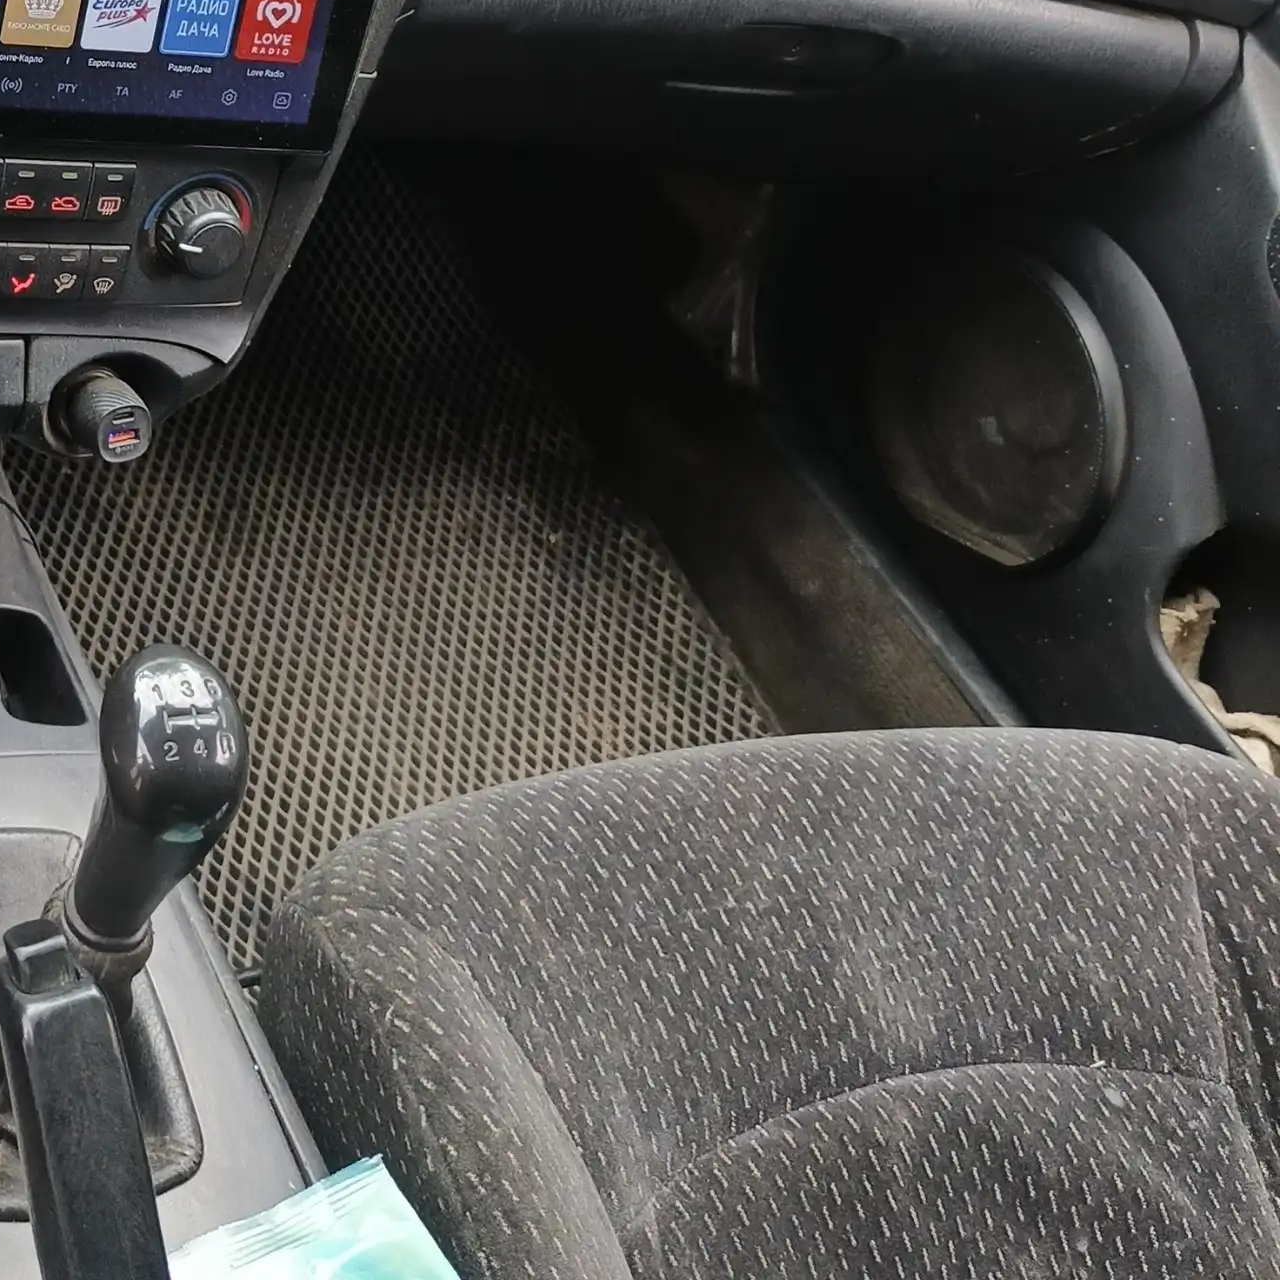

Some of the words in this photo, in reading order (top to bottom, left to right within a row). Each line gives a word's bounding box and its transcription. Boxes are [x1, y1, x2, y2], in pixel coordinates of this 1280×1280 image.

[176, 20, 219, 38] ДАЧА
[253, 32, 292, 46] LOVE
[251, 47, 289, 56] RADIO
[168, 62, 192, 73] Радио
[192, 64, 212, 74] Дача
[247, 68, 264, 77] Love
[264, 69, 285, 78] Radio
[57, 82, 78, 94] PTY
[116, 86, 129, 97] TA
[169, 90, 183, 100] AF
[152, 683, 164, 702] 1
[180, 679, 196, 698] 3
[163, 741, 180, 762] 2
[193, 738, 208, 757] 4
